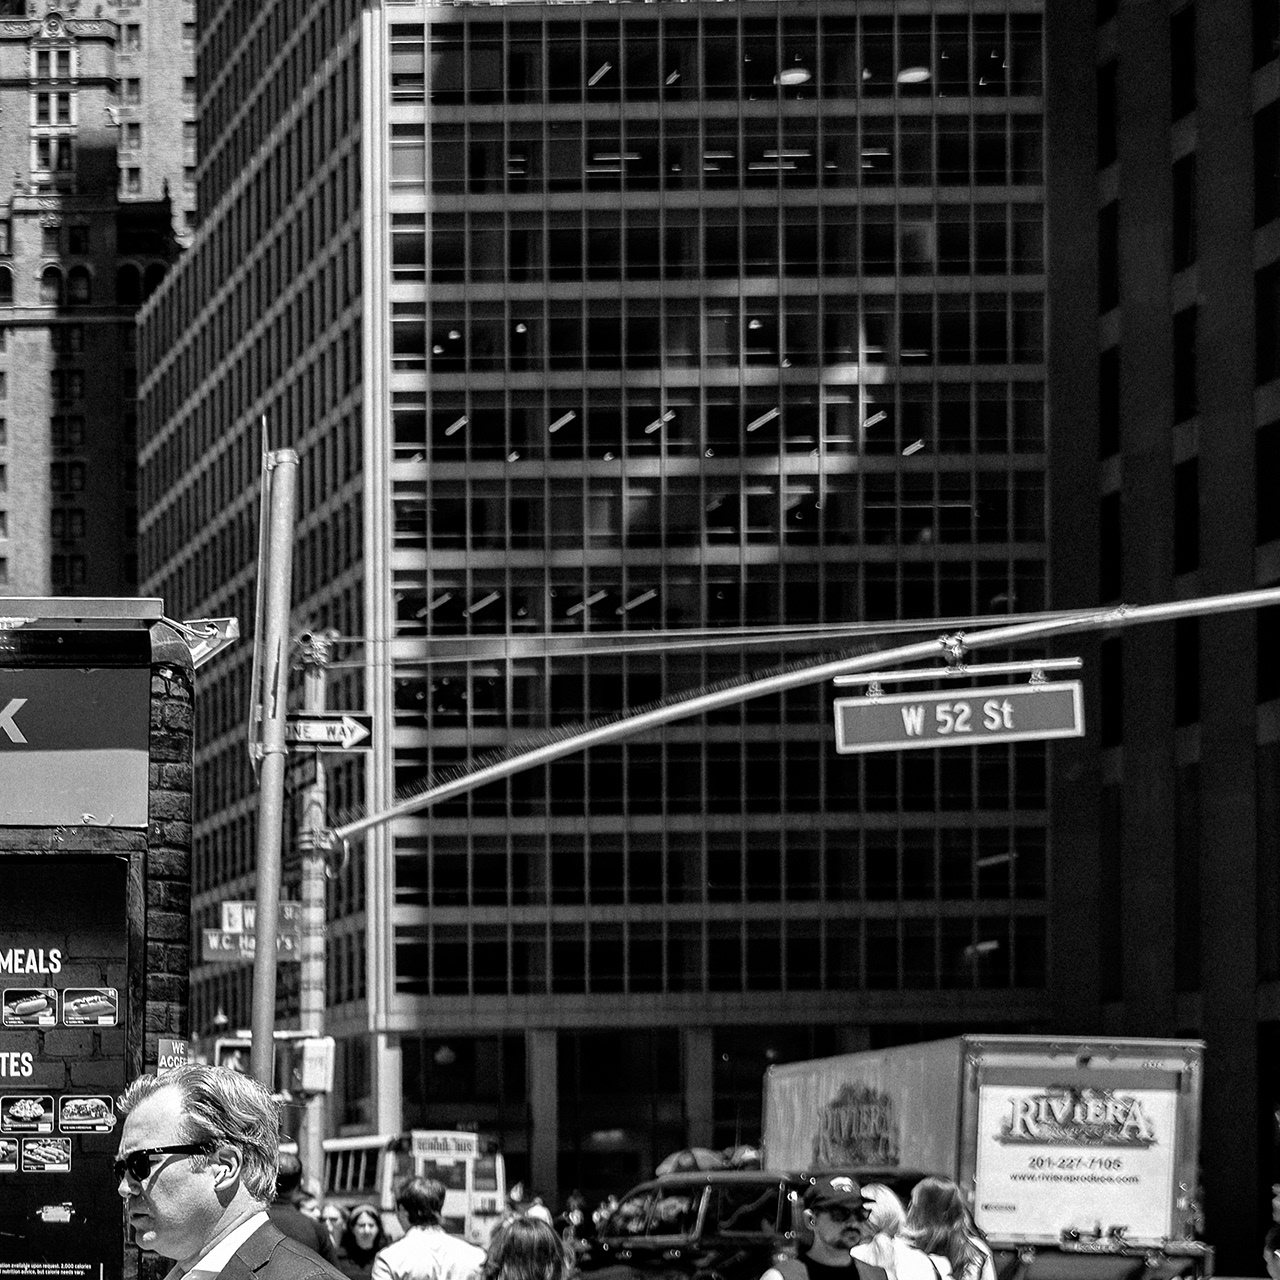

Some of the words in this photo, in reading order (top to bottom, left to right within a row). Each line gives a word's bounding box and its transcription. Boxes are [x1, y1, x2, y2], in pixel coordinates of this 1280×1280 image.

[901, 704, 926, 737] W
[935, 701, 972, 735] 52
[983, 698, 1015, 731] St
[326, 725, 355, 741] WAY
[171, 1041, 185, 1055] WE
[1008, 1097, 1156, 1140] RIVIERA
